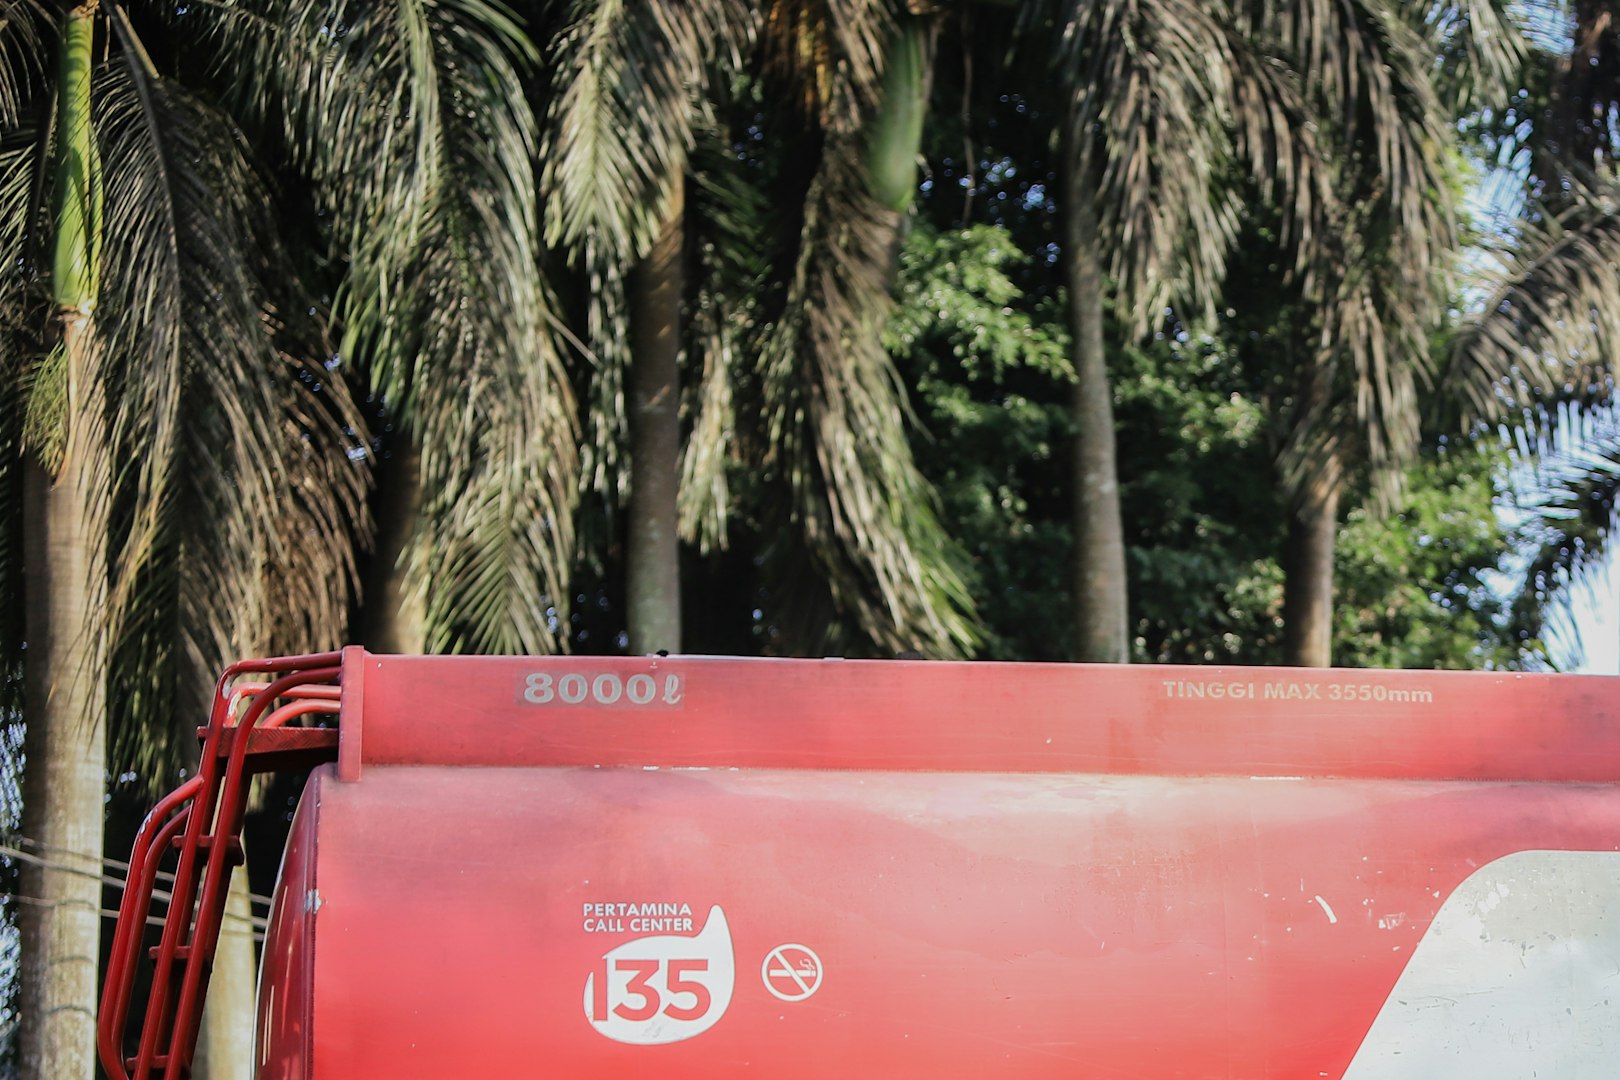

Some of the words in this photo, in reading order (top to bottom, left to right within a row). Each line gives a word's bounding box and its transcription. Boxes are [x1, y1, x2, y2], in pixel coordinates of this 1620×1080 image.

[1163, 681, 1255, 699] TINGGI
[1263, 682, 1322, 700] MAX
[1328, 683, 1434, 703] 3550mm
[583, 902, 693, 917] PERTAMINA
[583, 917, 625, 933] CALL
[629, 917, 694, 932] CENTER
[592, 957, 712, 1022] 135
